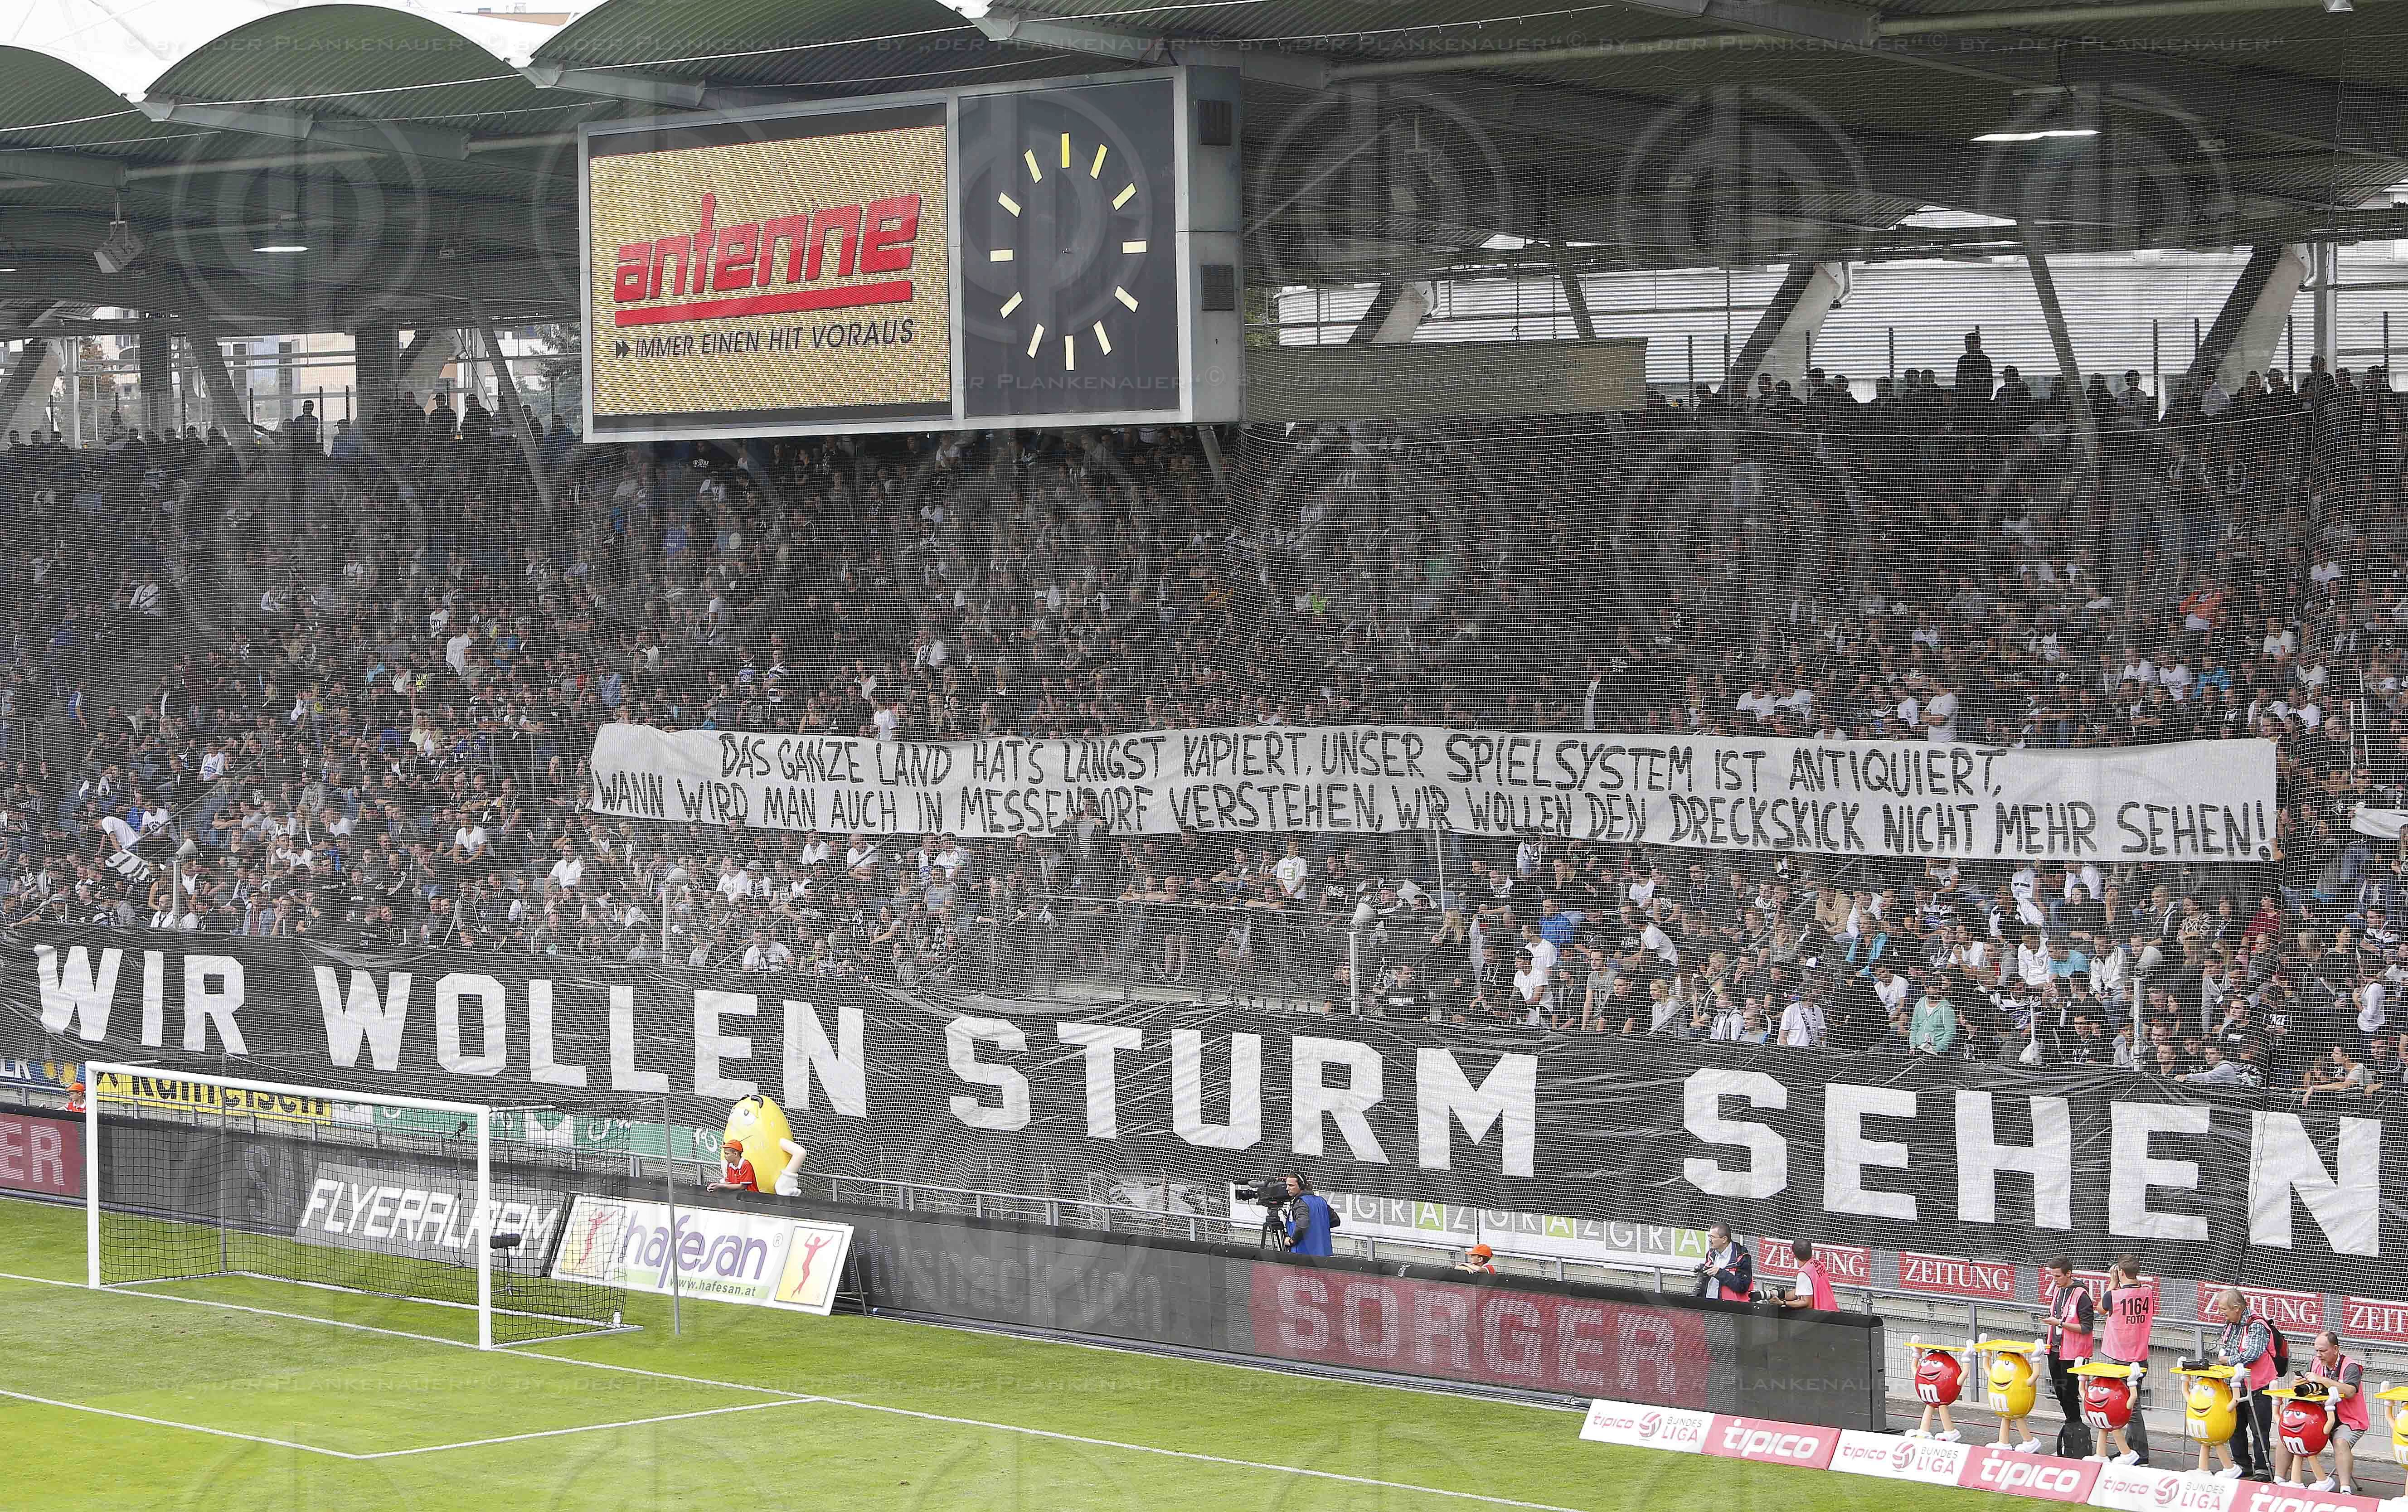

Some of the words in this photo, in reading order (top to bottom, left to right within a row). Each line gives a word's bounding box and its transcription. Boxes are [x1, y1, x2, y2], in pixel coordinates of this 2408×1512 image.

[613, 194, 921, 303] antenne
[635, 335, 694, 358] IMMER
[701, 331, 760, 355] EINEN
[771, 328, 805, 351] HIT
[811, 319, 914, 349] VORAUS
[719, 733, 771, 778] DAS
[777, 737, 864, 783] GANZE
[876, 742, 953, 787] LAND
[1183, 732, 1311, 777] KAPIERT,
[1321, 731, 1425, 778] UNSER
[1445, 734, 1693, 792] SPIELSYSTEM
[1715, 748, 1767, 793] IST
[1789, 745, 2007, 798] ANTIQUIERT,
[594, 769, 665, 818] WANN
[677, 778, 749, 825] WIRD
[764, 785, 816, 829] MAN
[831, 789, 897, 833] AUCH
[916, 790, 942, 834] IN
[1170, 780, 1384, 832] VERSTEHEN,
[1392, 784, 1452, 831] WIR
[1465, 786, 1572, 837] WOLLEN
[1584, 792, 1647, 842] DEN
[1668, 793, 1865, 852] DRECKSKICK
[1882, 801, 1979, 854] NICHT
[1995, 800, 2098, 857] MEHR
[2116, 799, 2272, 862] SEHEN!
[34, 944, 249, 1055] WIR
[312, 965, 867, 1118] WOLLEN
[944, 1015, 1539, 1179] STURM
[1682, 1067, 2381, 1258] SEHEN
[626, 1210, 767, 1289] hafesan
[1764, 1243, 1865, 1277] ZEUNG
[670, 1277, 757, 1298] www.hafesan.at
[1905, 1258, 2010, 1292] ZEITUNG
[2120, 1296, 2150, 1316] 1164
[2126, 1314, 2146, 1324] FOTO
[2203, 1291, 2319, 1324] ZTUNG
[1277, 1275, 1679, 1396] SORGER
[1593, 1411, 1635, 1430] tipico
[1661, 1425, 1699, 1443] LIGA
[1667, 1415, 1702, 1428] BUNDES
[1722, 1418, 1820, 1459] tipico
[1920, 1445, 1959, 1459] BUNDES
[1842, 1443, 1887, 1462] tipico
[1916, 1456, 1956, 1475] LIGA
[1980, 1450, 2082, 1493] tipico
[2102, 1475, 2149, 1495] tipico
[2180, 1491, 2222, 1511] LIGA
[2185, 1481, 2226, 1495] BUNDES
